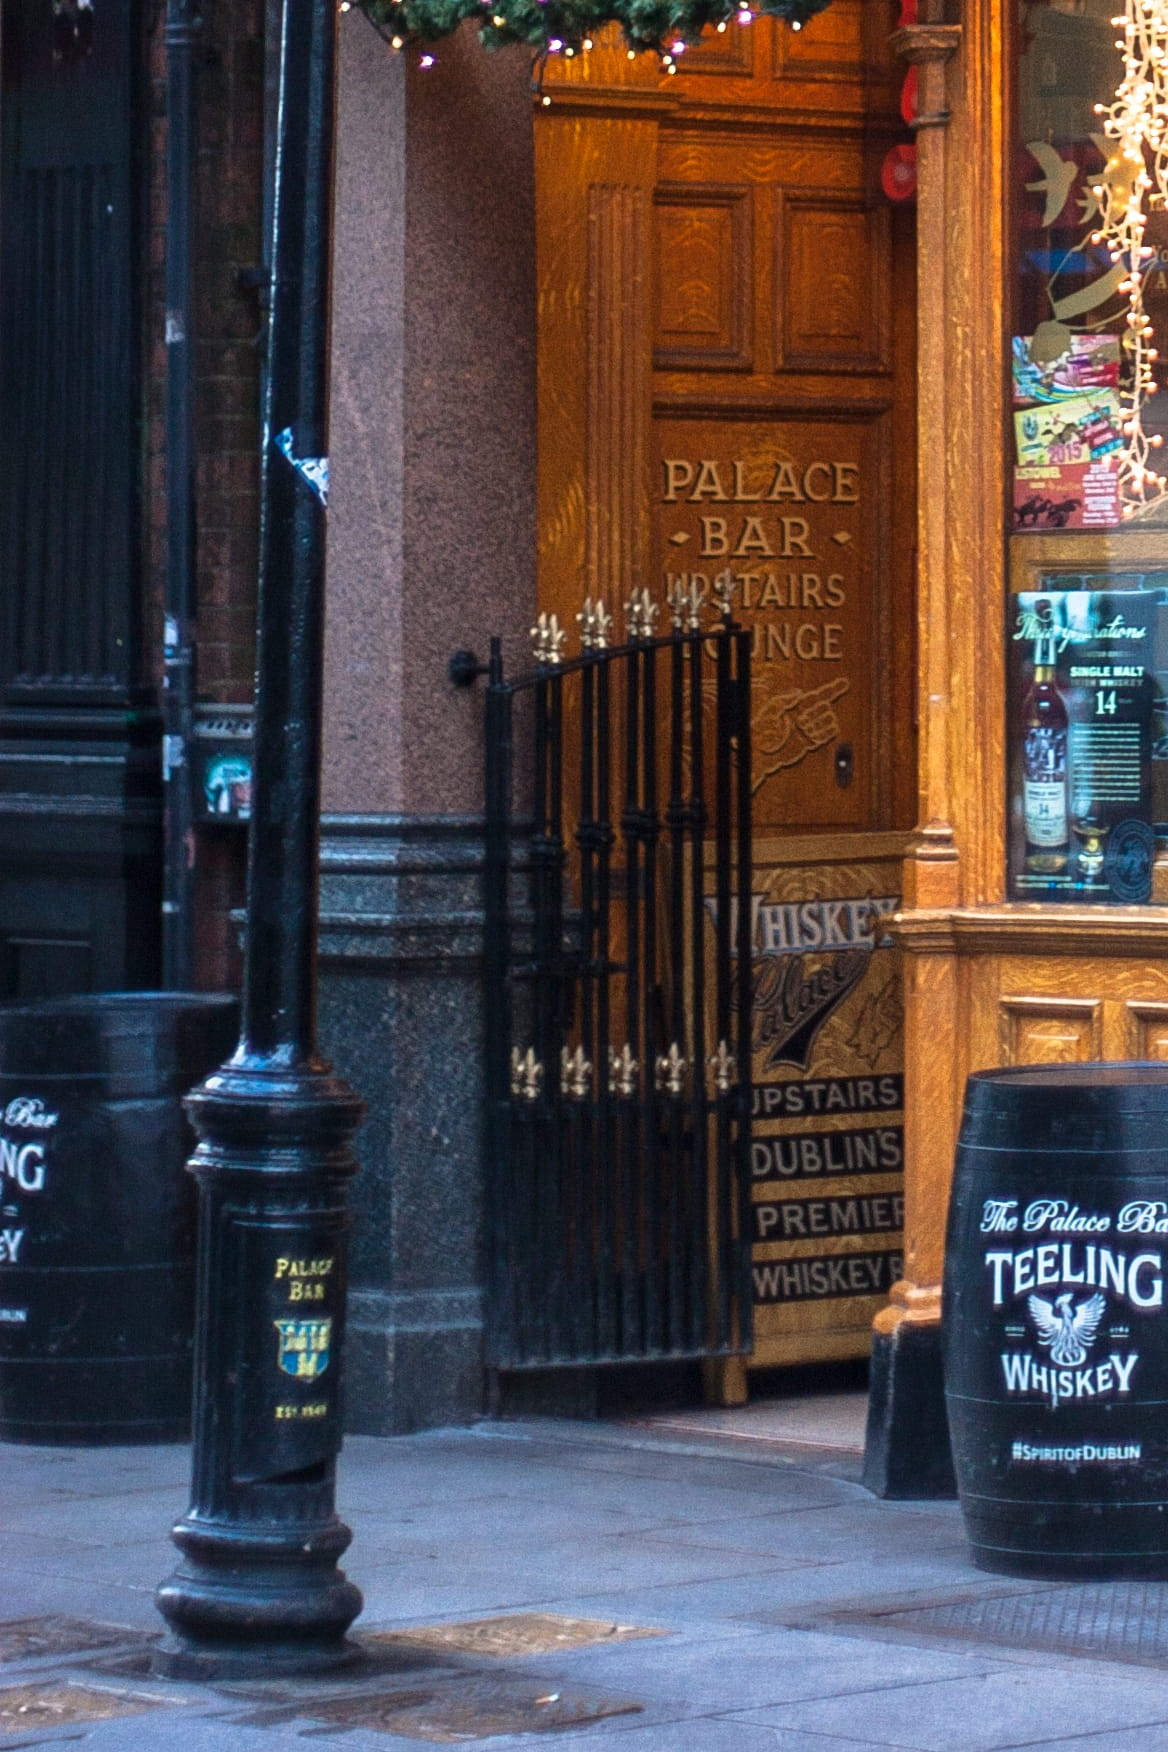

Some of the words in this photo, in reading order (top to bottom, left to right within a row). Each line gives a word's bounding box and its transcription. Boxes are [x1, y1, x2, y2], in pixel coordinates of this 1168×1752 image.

[1048, 441, 1082, 465] 2015
[662, 458, 860, 503] PALACE
[699, 516, 816, 558] BAR
[1095, 690, 1117, 715] 14
[752, 1129, 902, 1176] DUBLIN'S
[980, 1199, 1018, 1234] The
[1022, 1199, 1110, 1234] Palace
[289, 1280, 325, 1301] BAR
[752, 1256, 883, 1298] WHISKEY
[985, 1244, 1164, 1308] TEELING
[1000, 1351, 1139, 1399] WHISKEY
